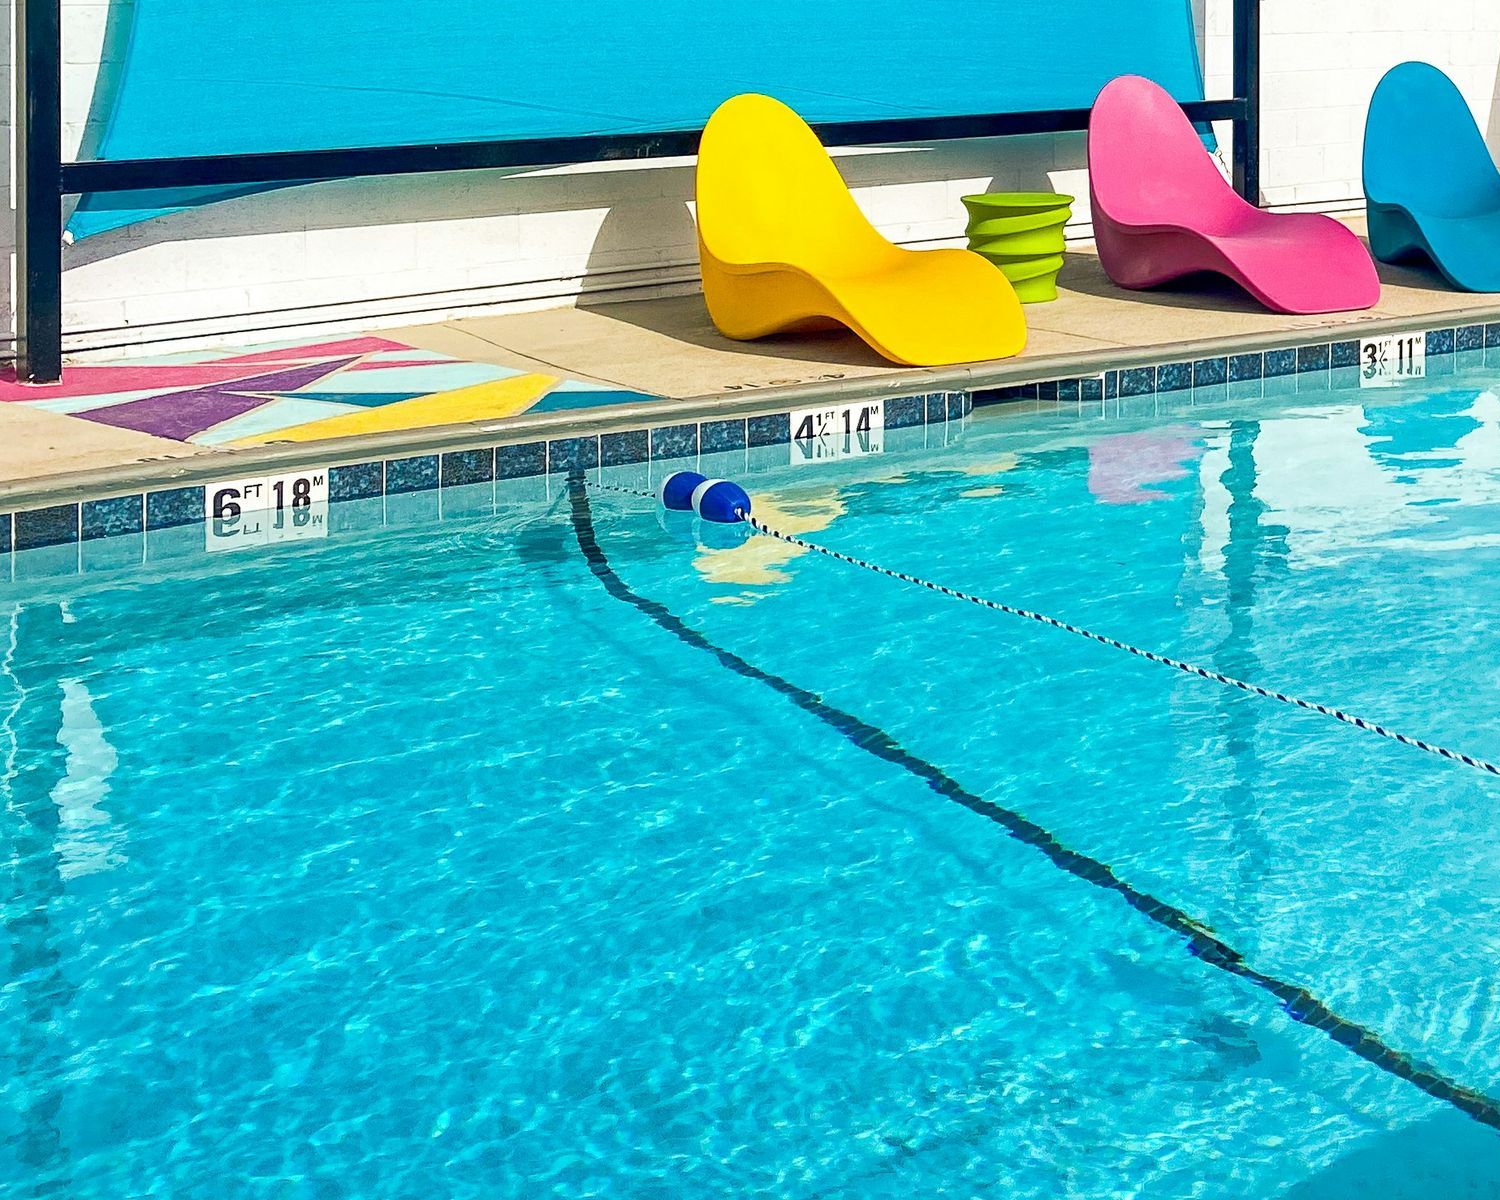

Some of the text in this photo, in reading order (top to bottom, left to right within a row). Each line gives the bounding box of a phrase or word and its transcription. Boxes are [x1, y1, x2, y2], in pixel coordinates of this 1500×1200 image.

[870, 405, 880, 416] M
[243, 483, 263, 500] FT
[312, 475, 324, 487] M
